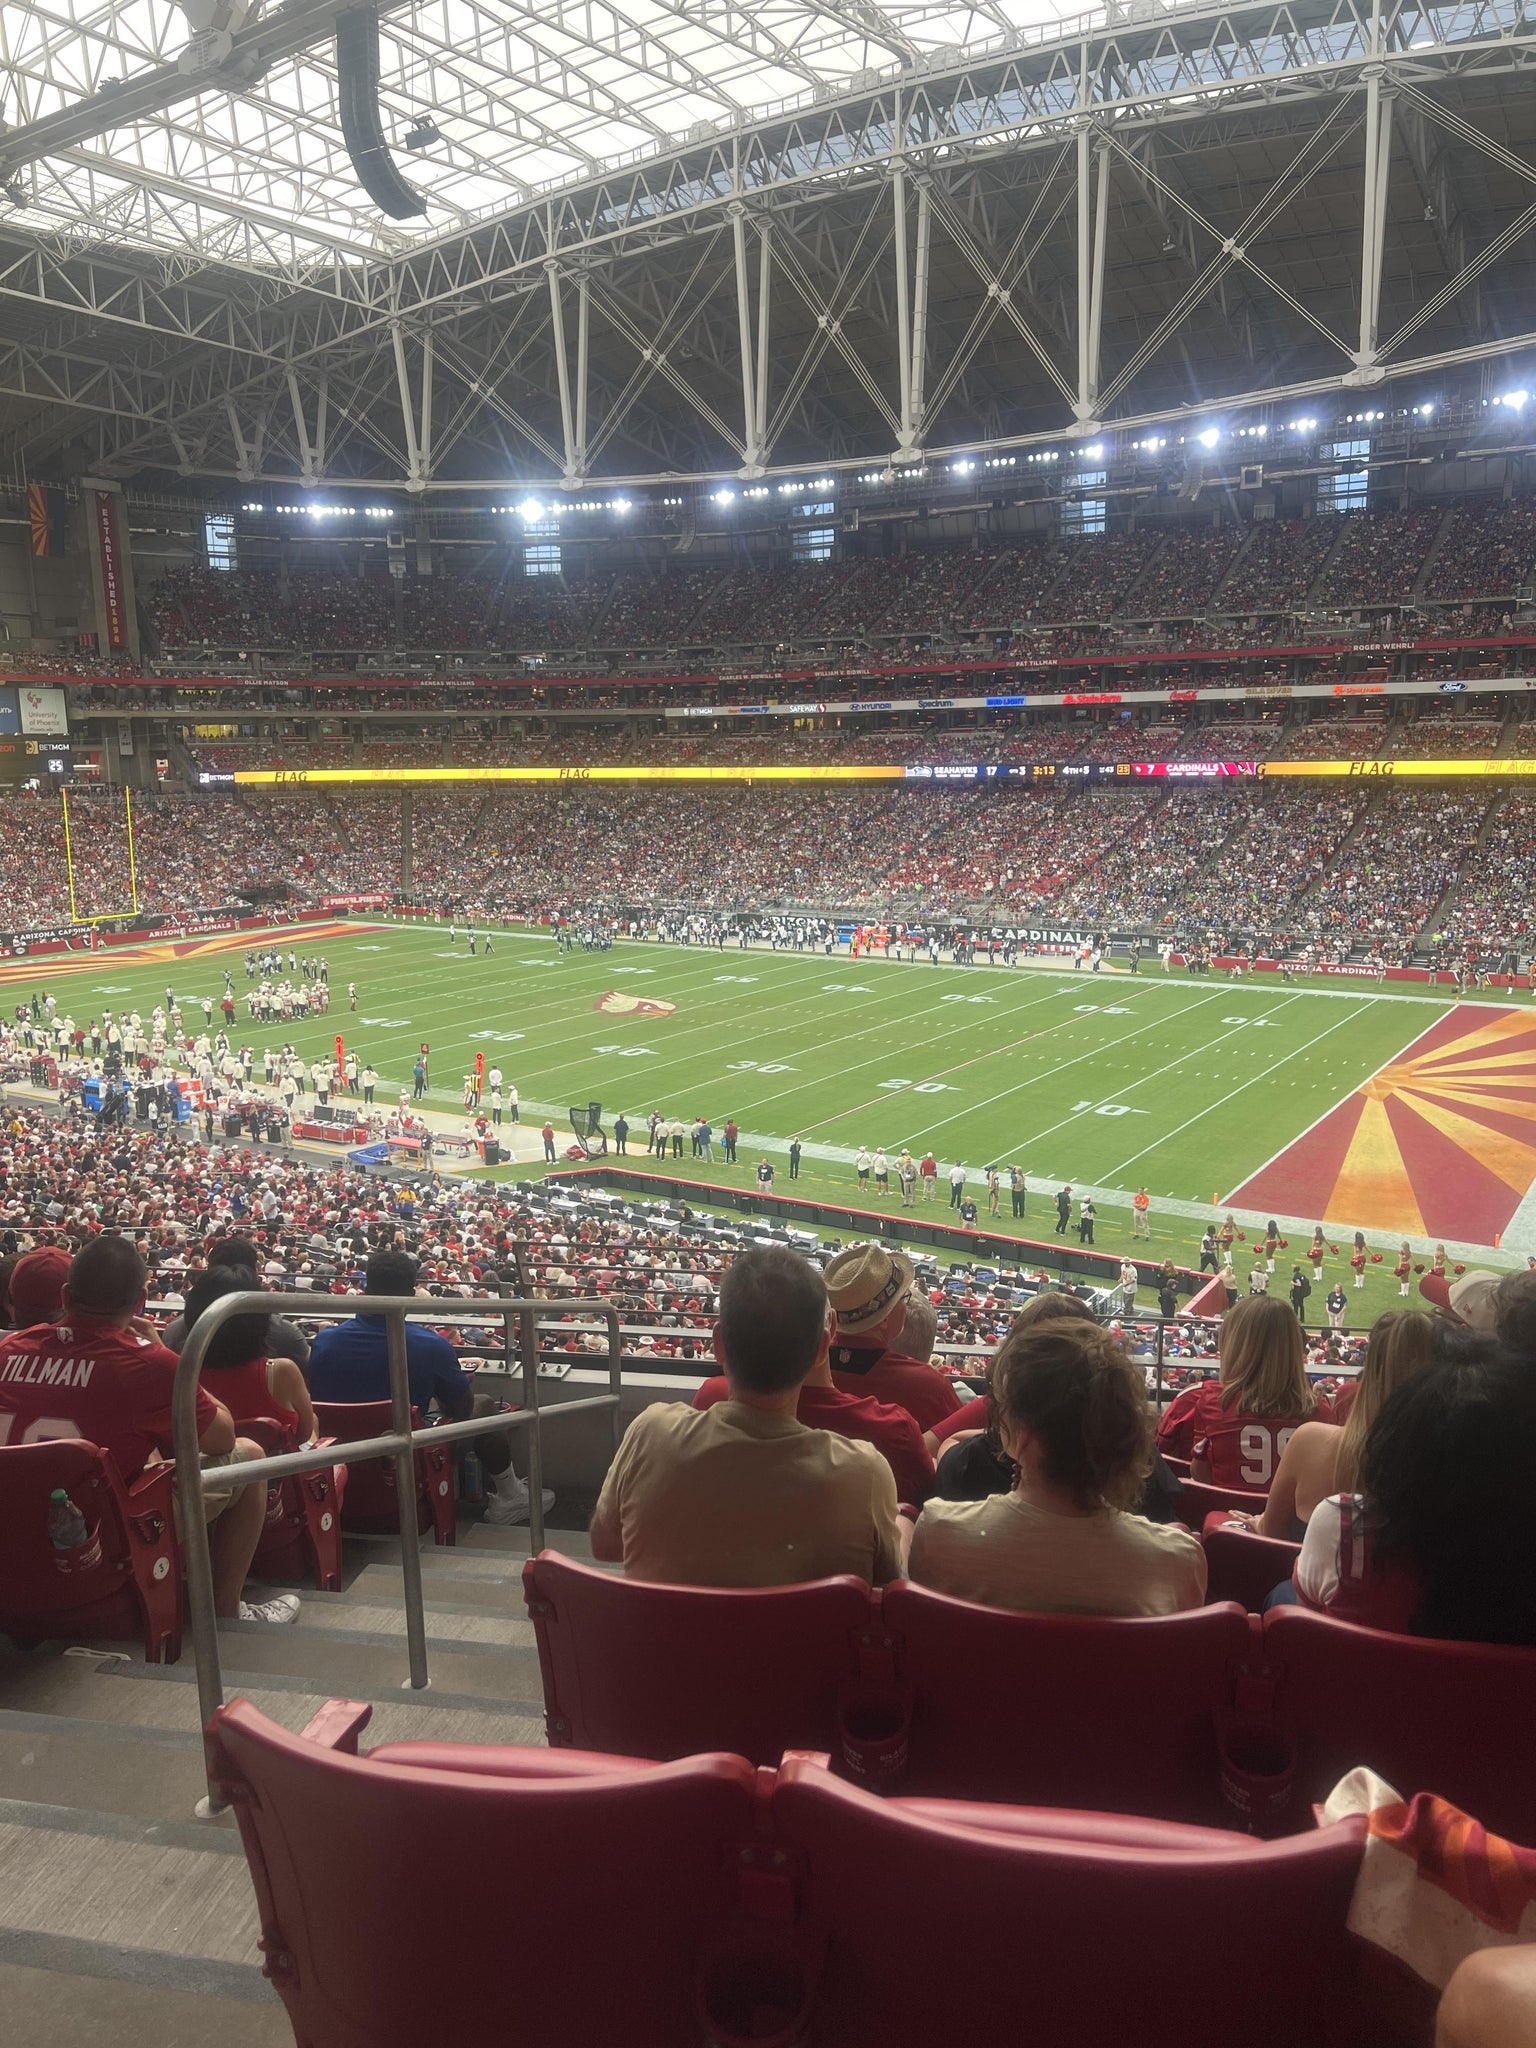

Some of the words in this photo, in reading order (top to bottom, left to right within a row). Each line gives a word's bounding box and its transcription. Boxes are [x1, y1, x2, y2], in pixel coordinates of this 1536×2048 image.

[102, 508, 117, 607] ESTABLISHED
[111, 608, 120, 643] 1898
[1382, 642, 1415, 650] WEHRLI
[1443, 684, 1462, 692] Ford
[789, 704, 817, 713] SAFEWAY
[918, 700, 952, 709] Spectrum
[50, 760, 63, 771] 25
[934, 766, 978, 774] SEAHAWKS
[986, 766, 997, 776] 17
[1018, 766, 1026, 775] 3
[1032, 766, 1056, 775] 3:13
[1147, 765, 1155, 774] 7
[1166, 764, 1219, 772] CARDINALS
[1349, 762, 1394, 775] FLAG
[274, 771, 308, 782] FLAG
[559, 768, 591, 779] FLAG
[20, 932, 55, 940] ARIZONA
[148, 929, 183, 938] ARIZON
[1276, 963, 1323, 973] ARIZOA
[468, 1030, 526, 1041] 50
[592, 1045, 651, 1056] 40
[726, 1060, 790, 1073] 30
[876, 1078, 948, 1093] 20
[1069, 1101, 1131, 1116] 10
[0, 1355, 95, 1388] TILLMAN
